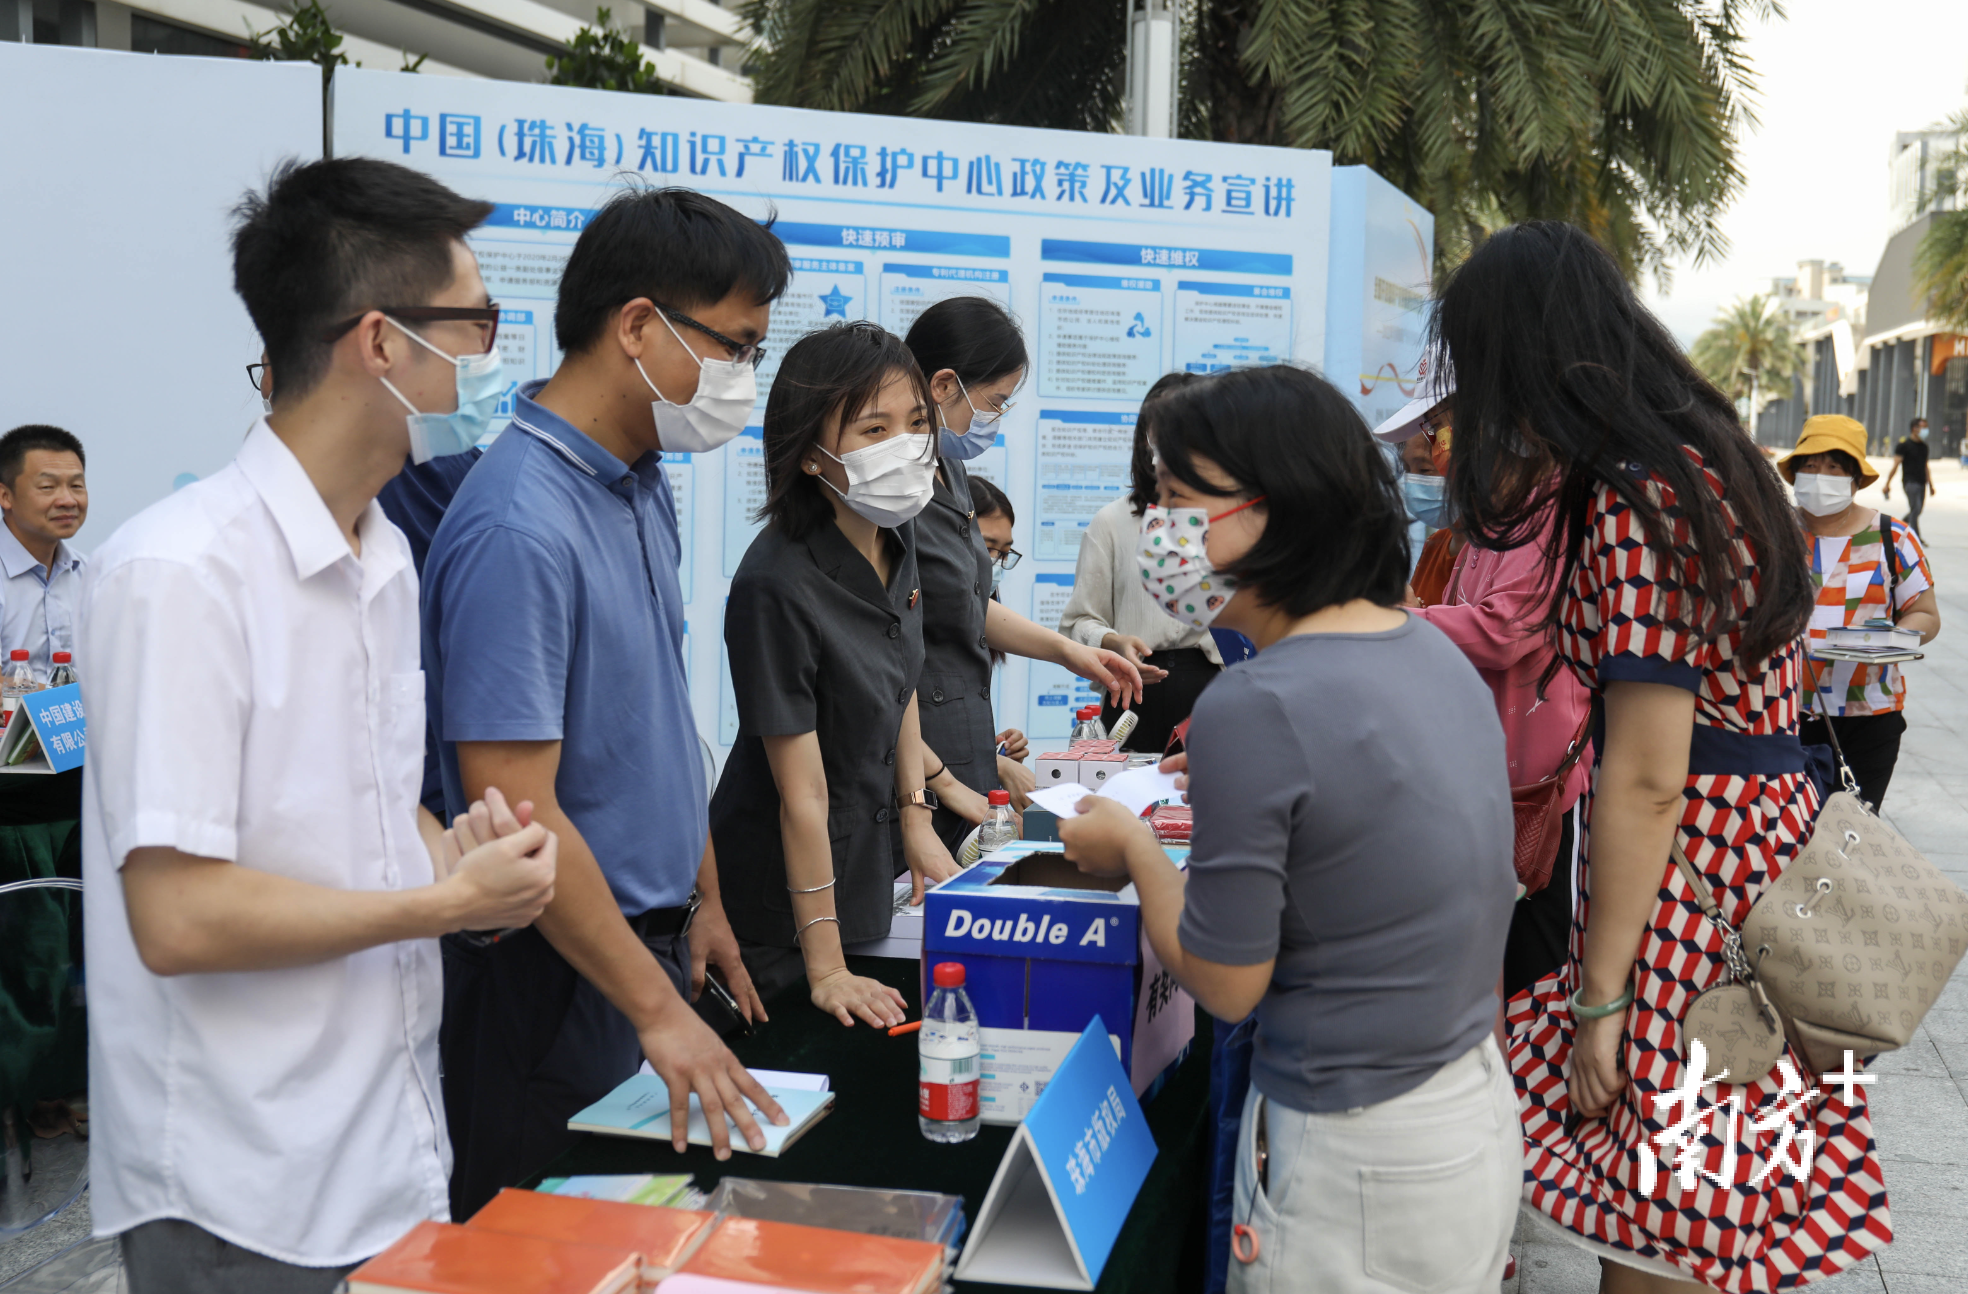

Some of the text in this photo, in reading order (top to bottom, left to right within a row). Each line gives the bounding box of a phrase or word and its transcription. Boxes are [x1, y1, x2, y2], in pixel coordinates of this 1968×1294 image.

[384, 108, 1296, 218] 中国(珠海)知识产权保护中心政策及业务宣讲
[513, 207, 585, 229] 中心简介
[841, 228, 906, 248] 快速预审
[790, 259, 856, 273] 审服务主体备案
[1140, 248, 1199, 267] 快速维权
[664, 450, 684, 462] 务部
[39, 700, 85, 727] 中国建设
[50, 728, 87, 754] 有限公
[944, 909, 1106, 947] Double A
[1066, 1084, 1127, 1195] 珠海市版权局
